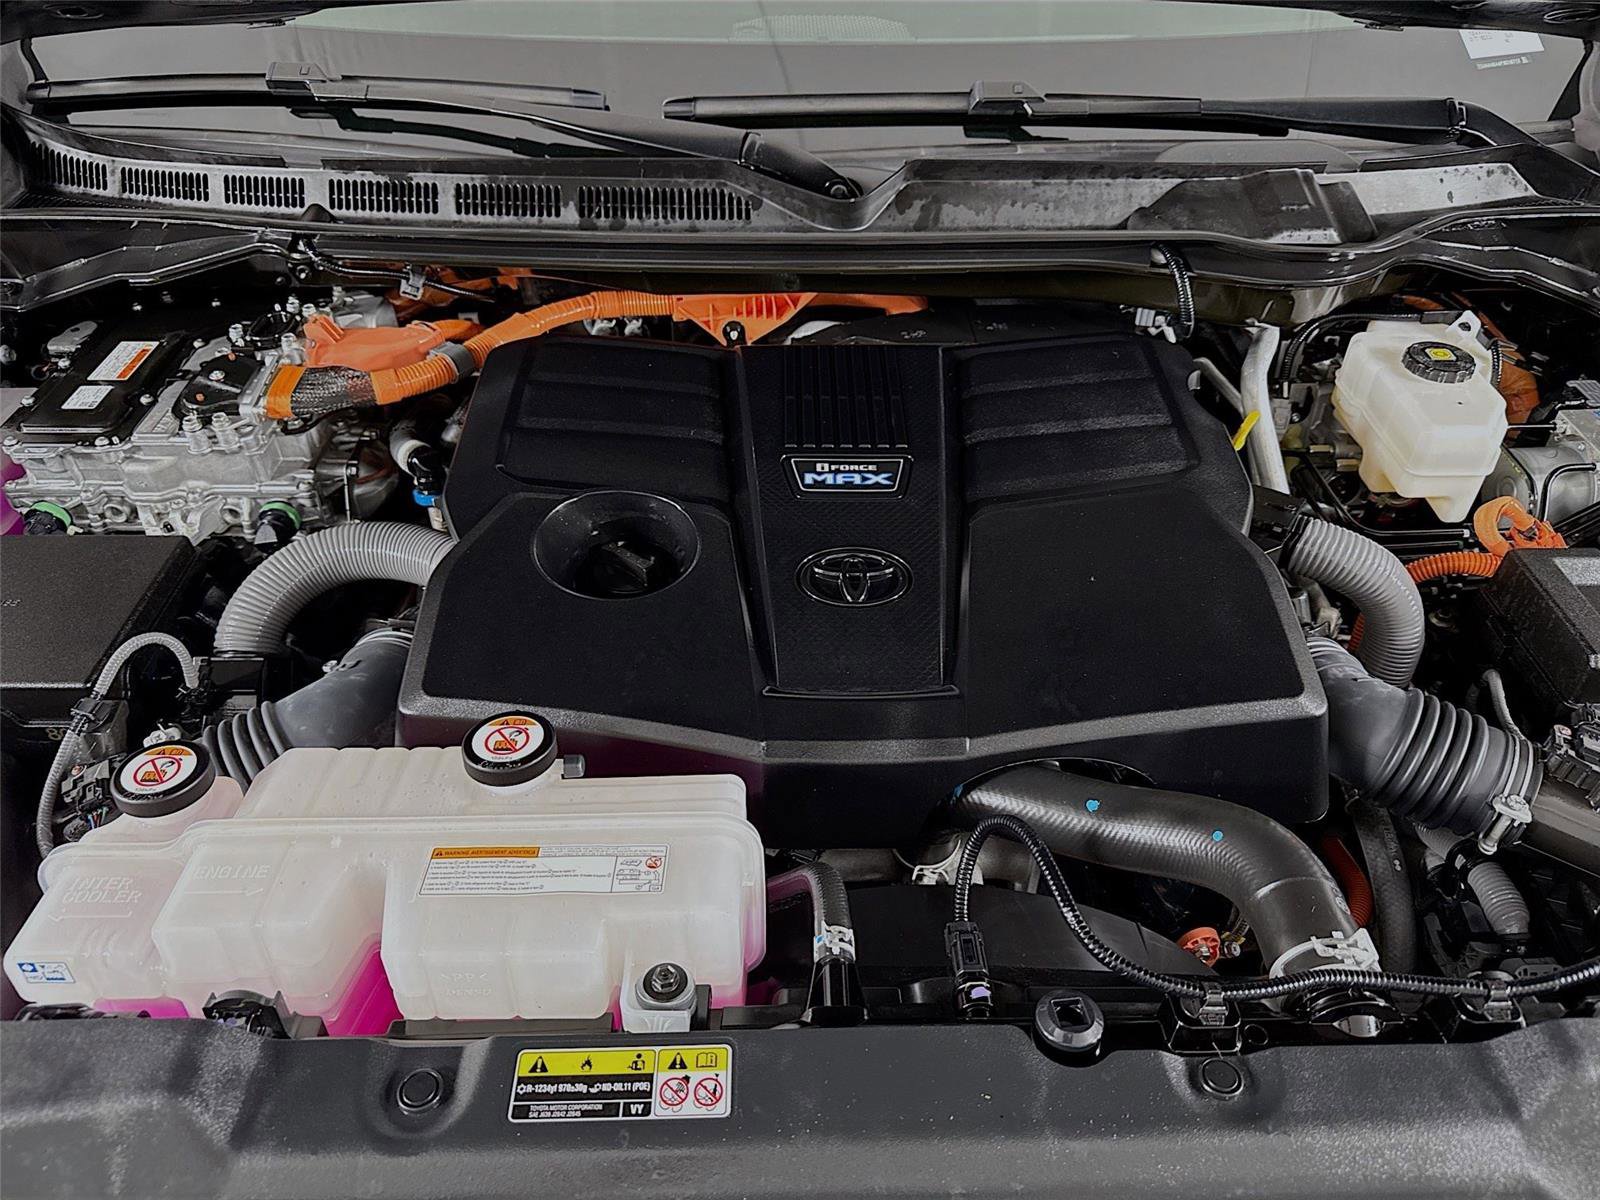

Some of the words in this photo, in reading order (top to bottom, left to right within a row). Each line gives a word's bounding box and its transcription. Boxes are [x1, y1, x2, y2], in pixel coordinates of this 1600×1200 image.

[804, 473, 894, 485] MAX
[193, 865, 271, 880] ENGINE
[69, 876, 134, 890] INTER
[62, 890, 143, 904] COOLER
[629, 1103, 645, 1115] VY
